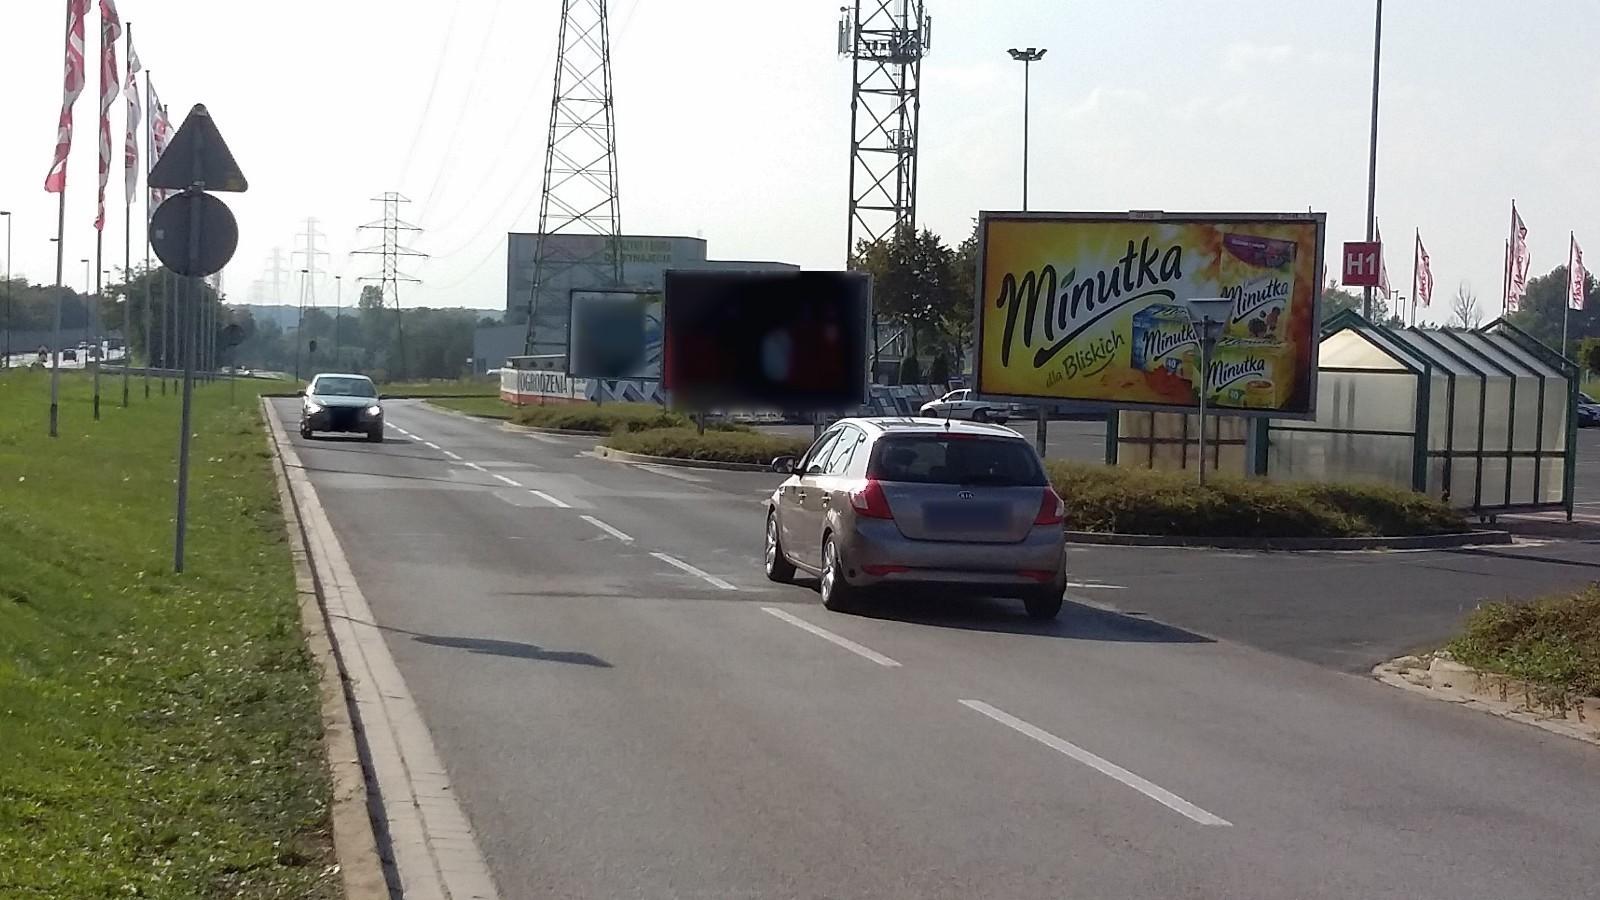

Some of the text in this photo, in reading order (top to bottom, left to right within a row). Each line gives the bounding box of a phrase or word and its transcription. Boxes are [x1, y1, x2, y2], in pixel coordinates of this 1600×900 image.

[1346, 252, 1376, 275] H1
[996, 236, 1182, 367] Minutka
[1220, 278, 1289, 315] Minutka
[1046, 330, 1125, 388] dla Bliskich
[1206, 354, 1265, 392] Minutka
[520, 373, 568, 393] OGRODZENIA
